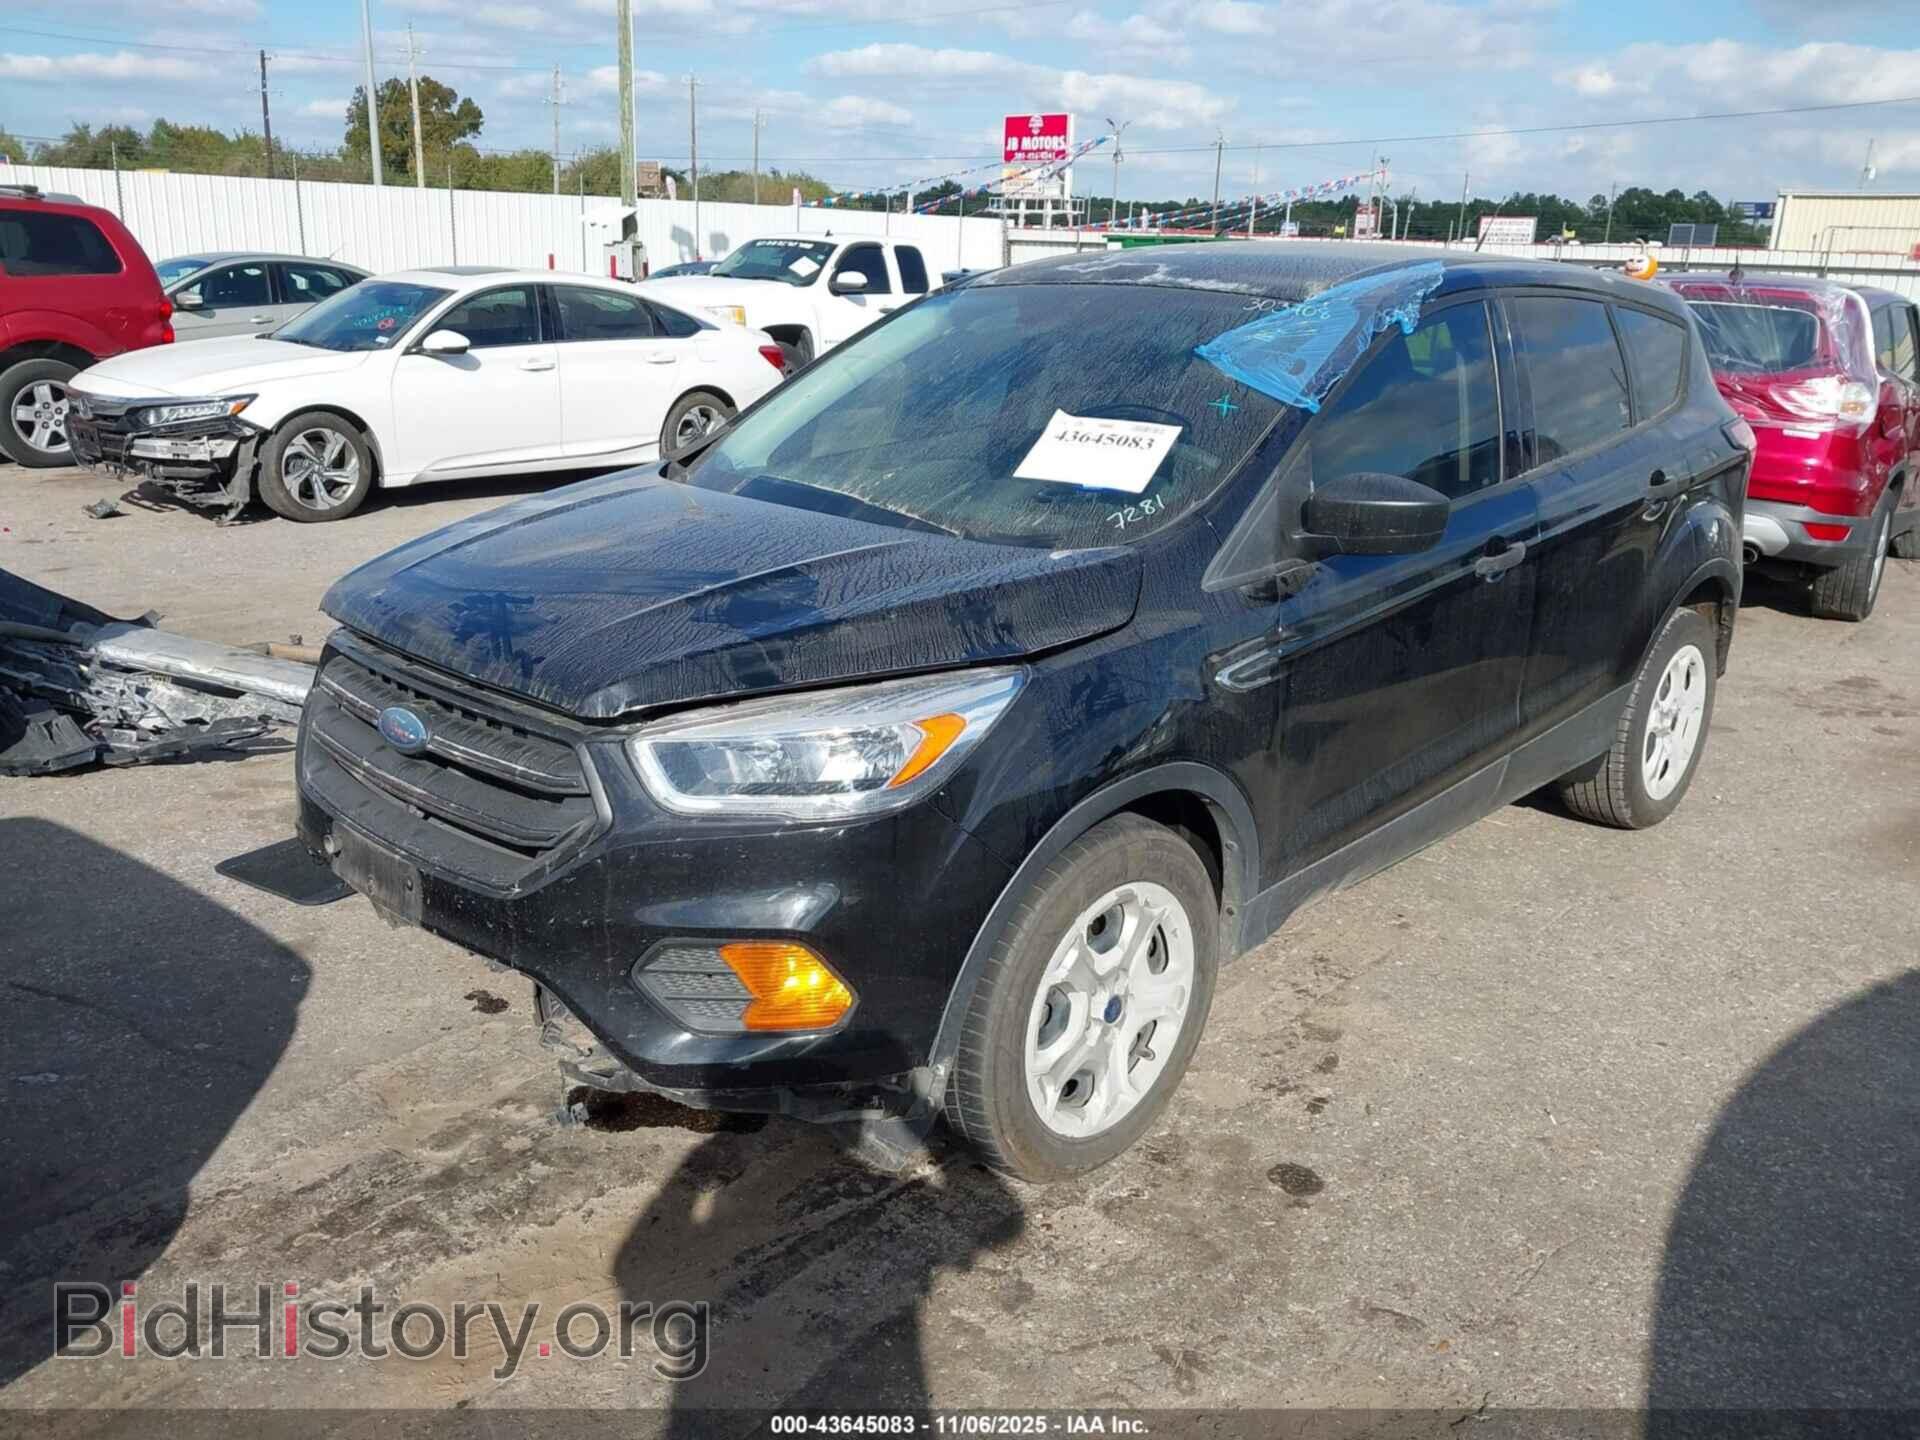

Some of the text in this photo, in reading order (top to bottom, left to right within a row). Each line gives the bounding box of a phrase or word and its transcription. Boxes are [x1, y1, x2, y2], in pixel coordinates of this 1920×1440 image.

[1021, 135, 1066, 150] MOTORS
[1055, 430, 1155, 450] 43645083
[1106, 494, 1165, 530] 7281
